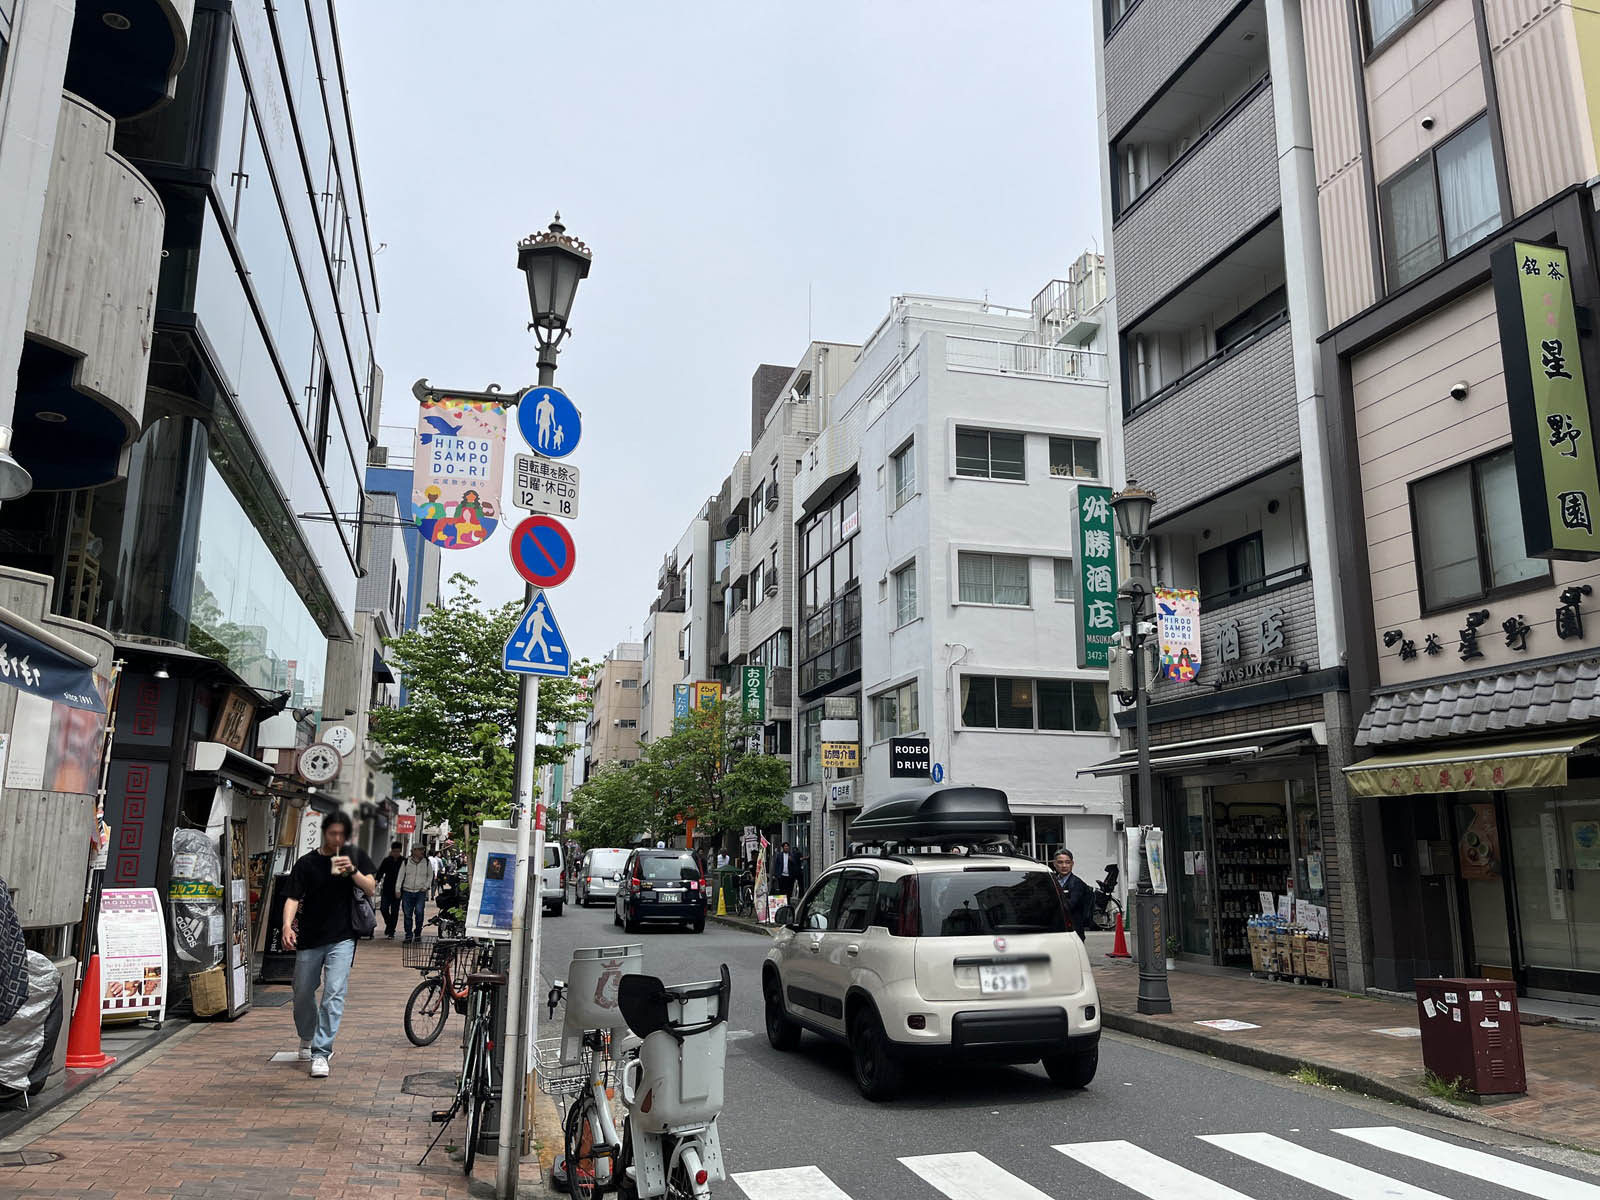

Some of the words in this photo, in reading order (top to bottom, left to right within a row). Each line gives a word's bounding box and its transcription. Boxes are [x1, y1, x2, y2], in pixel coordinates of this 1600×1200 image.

[1521, 255, 1565, 281] 銘茶
[1540, 338, 1593, 536] 星野園
[435, 438, 489, 452] HIROO
[434, 451, 488, 464] SAMPO
[433, 463, 485, 477] DO-RI
[518, 457, 576, 483] 自転車を除く
[521, 491, 534, 506] 12
[560, 499, 571, 514] 18
[1164, 617, 1191, 625] HIROO
[1164, 624, 1192, 632] SAMPO
[1086, 634, 1119, 645] MASUKA
[1164, 632, 1191, 640] DO-RI
[895, 745, 929, 754] RODEO
[896, 760, 929, 769] DRIVE
[176, 915, 198, 949] adidas
